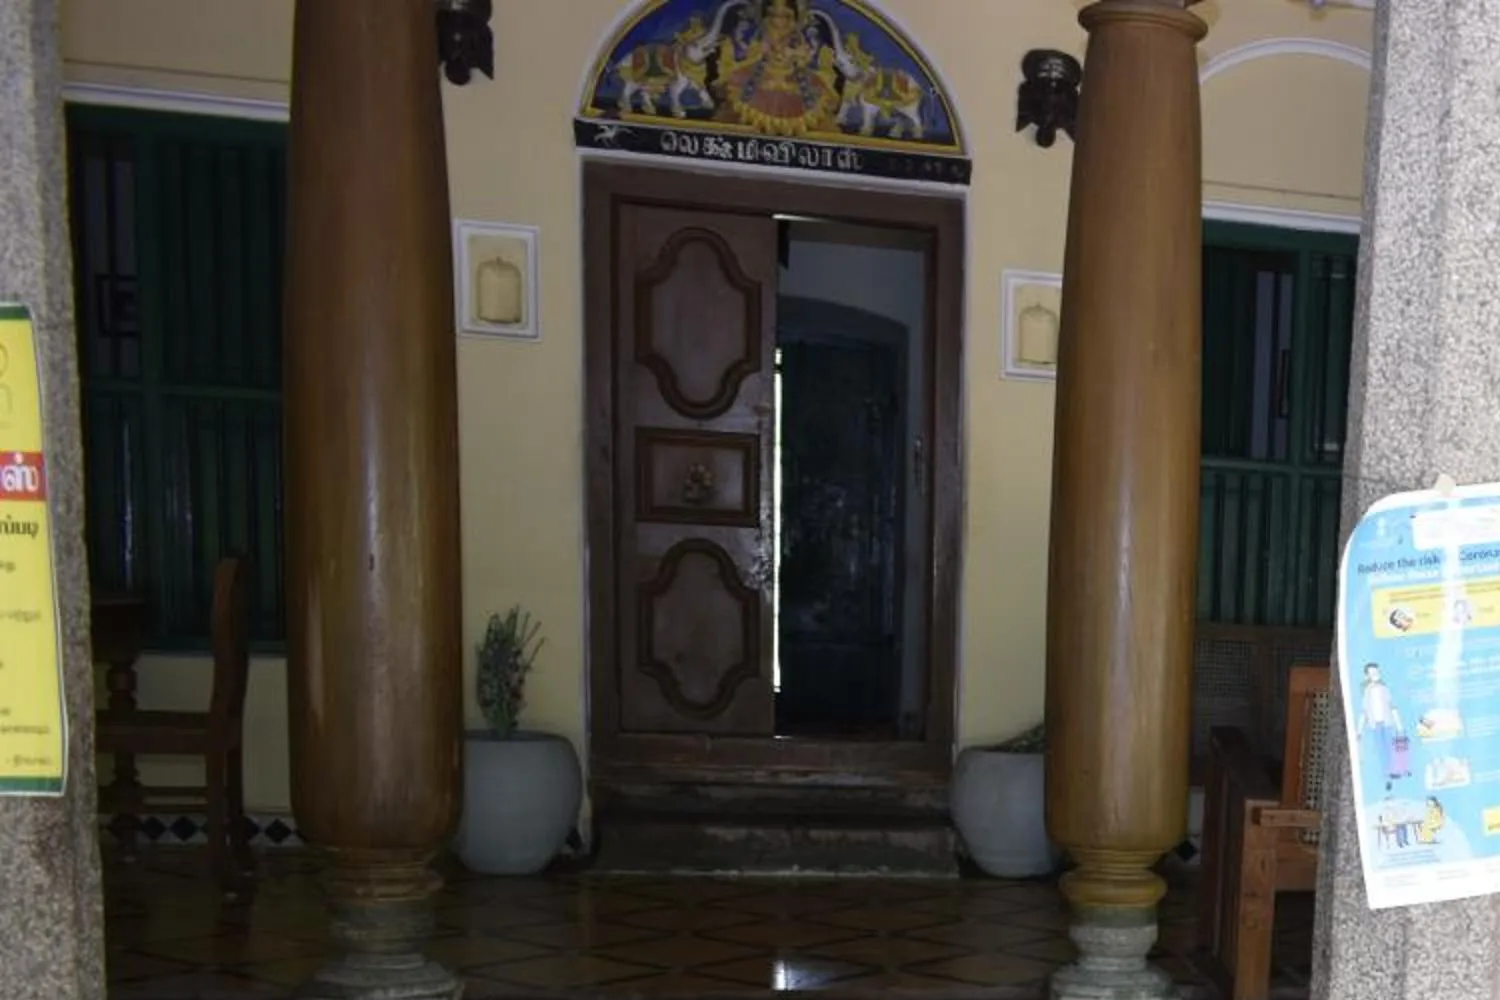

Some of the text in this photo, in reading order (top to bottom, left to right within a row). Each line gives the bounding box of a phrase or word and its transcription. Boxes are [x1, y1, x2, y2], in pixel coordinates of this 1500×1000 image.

[0, 451, 40, 493] ஸ்
[1357, 557, 1396, 575] Reduce
[1397, 555, 1417, 570] the
[1419, 551, 1441, 567] risk
